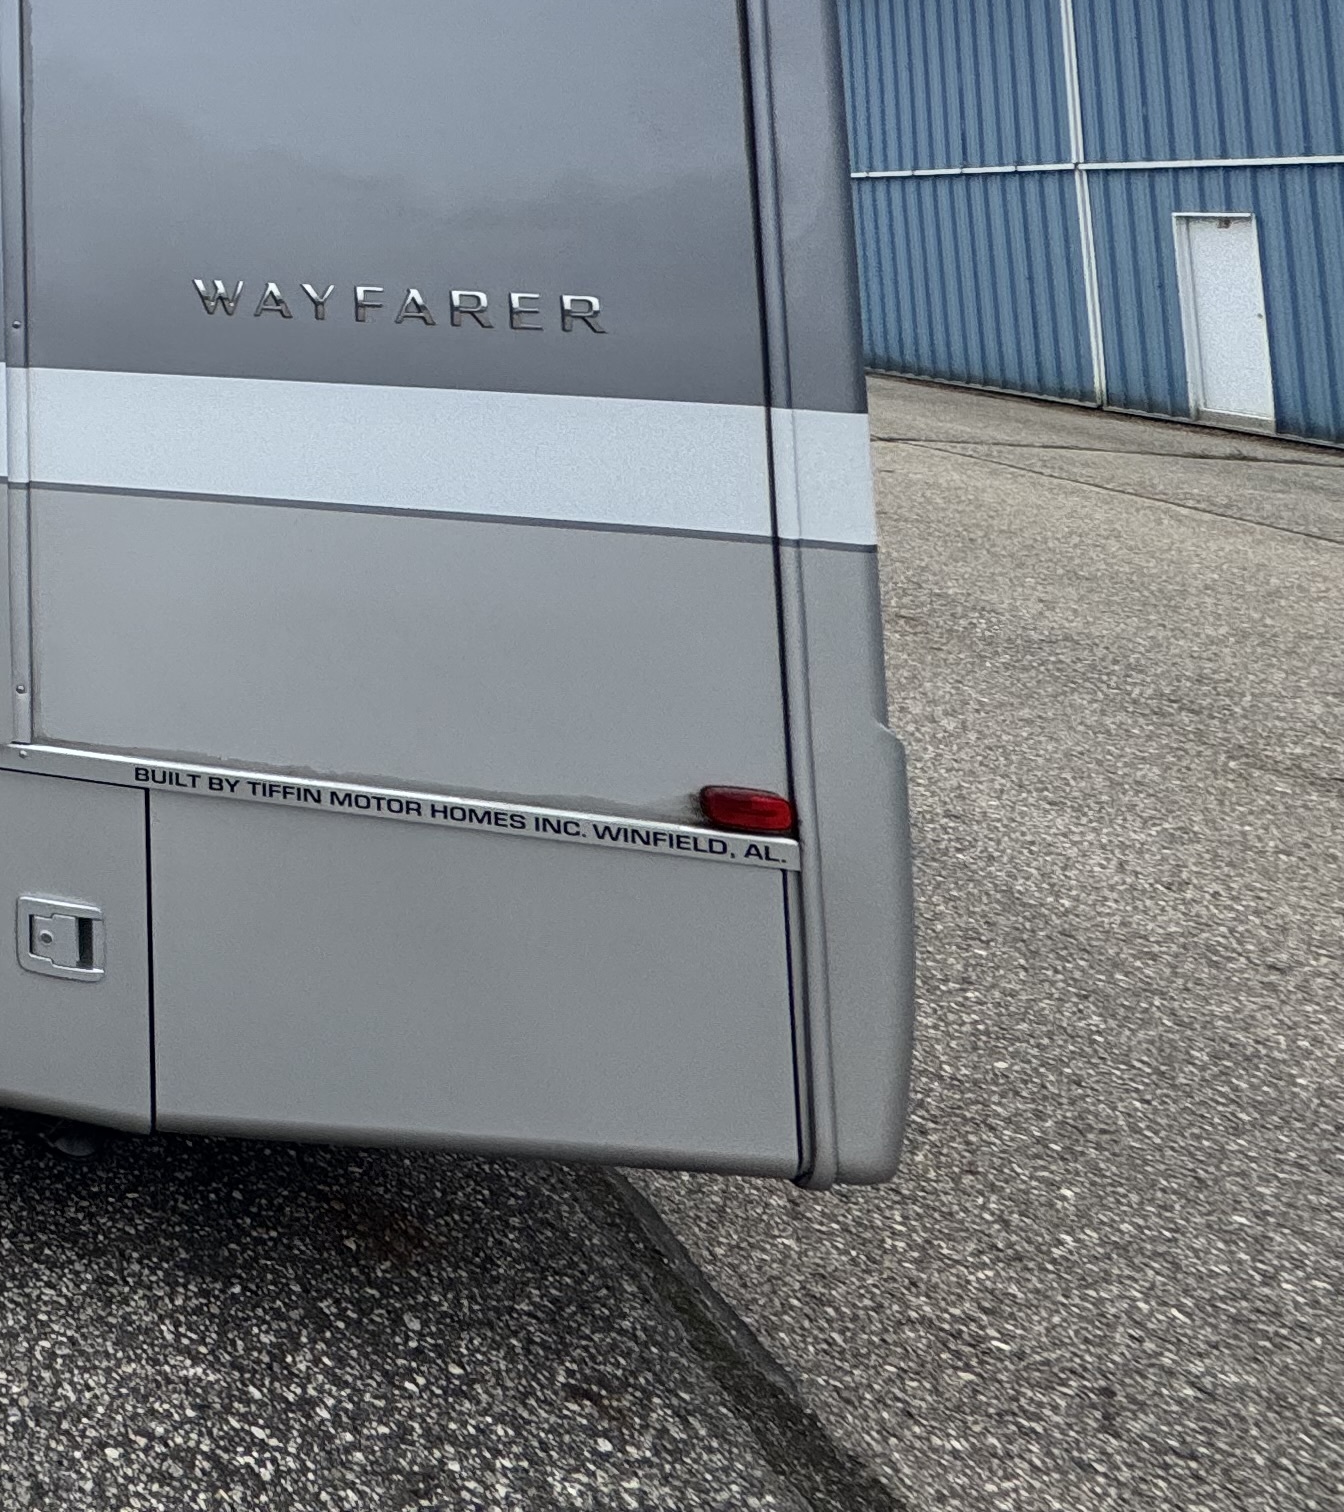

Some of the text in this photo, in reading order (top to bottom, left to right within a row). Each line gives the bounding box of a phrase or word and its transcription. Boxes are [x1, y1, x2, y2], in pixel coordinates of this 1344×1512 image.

[193, 278, 608, 333] WAYFARER
[134, 767, 788, 864] BUILT BY TIFFIN MOTOR HOMES INC. WINFIELD, AL.
